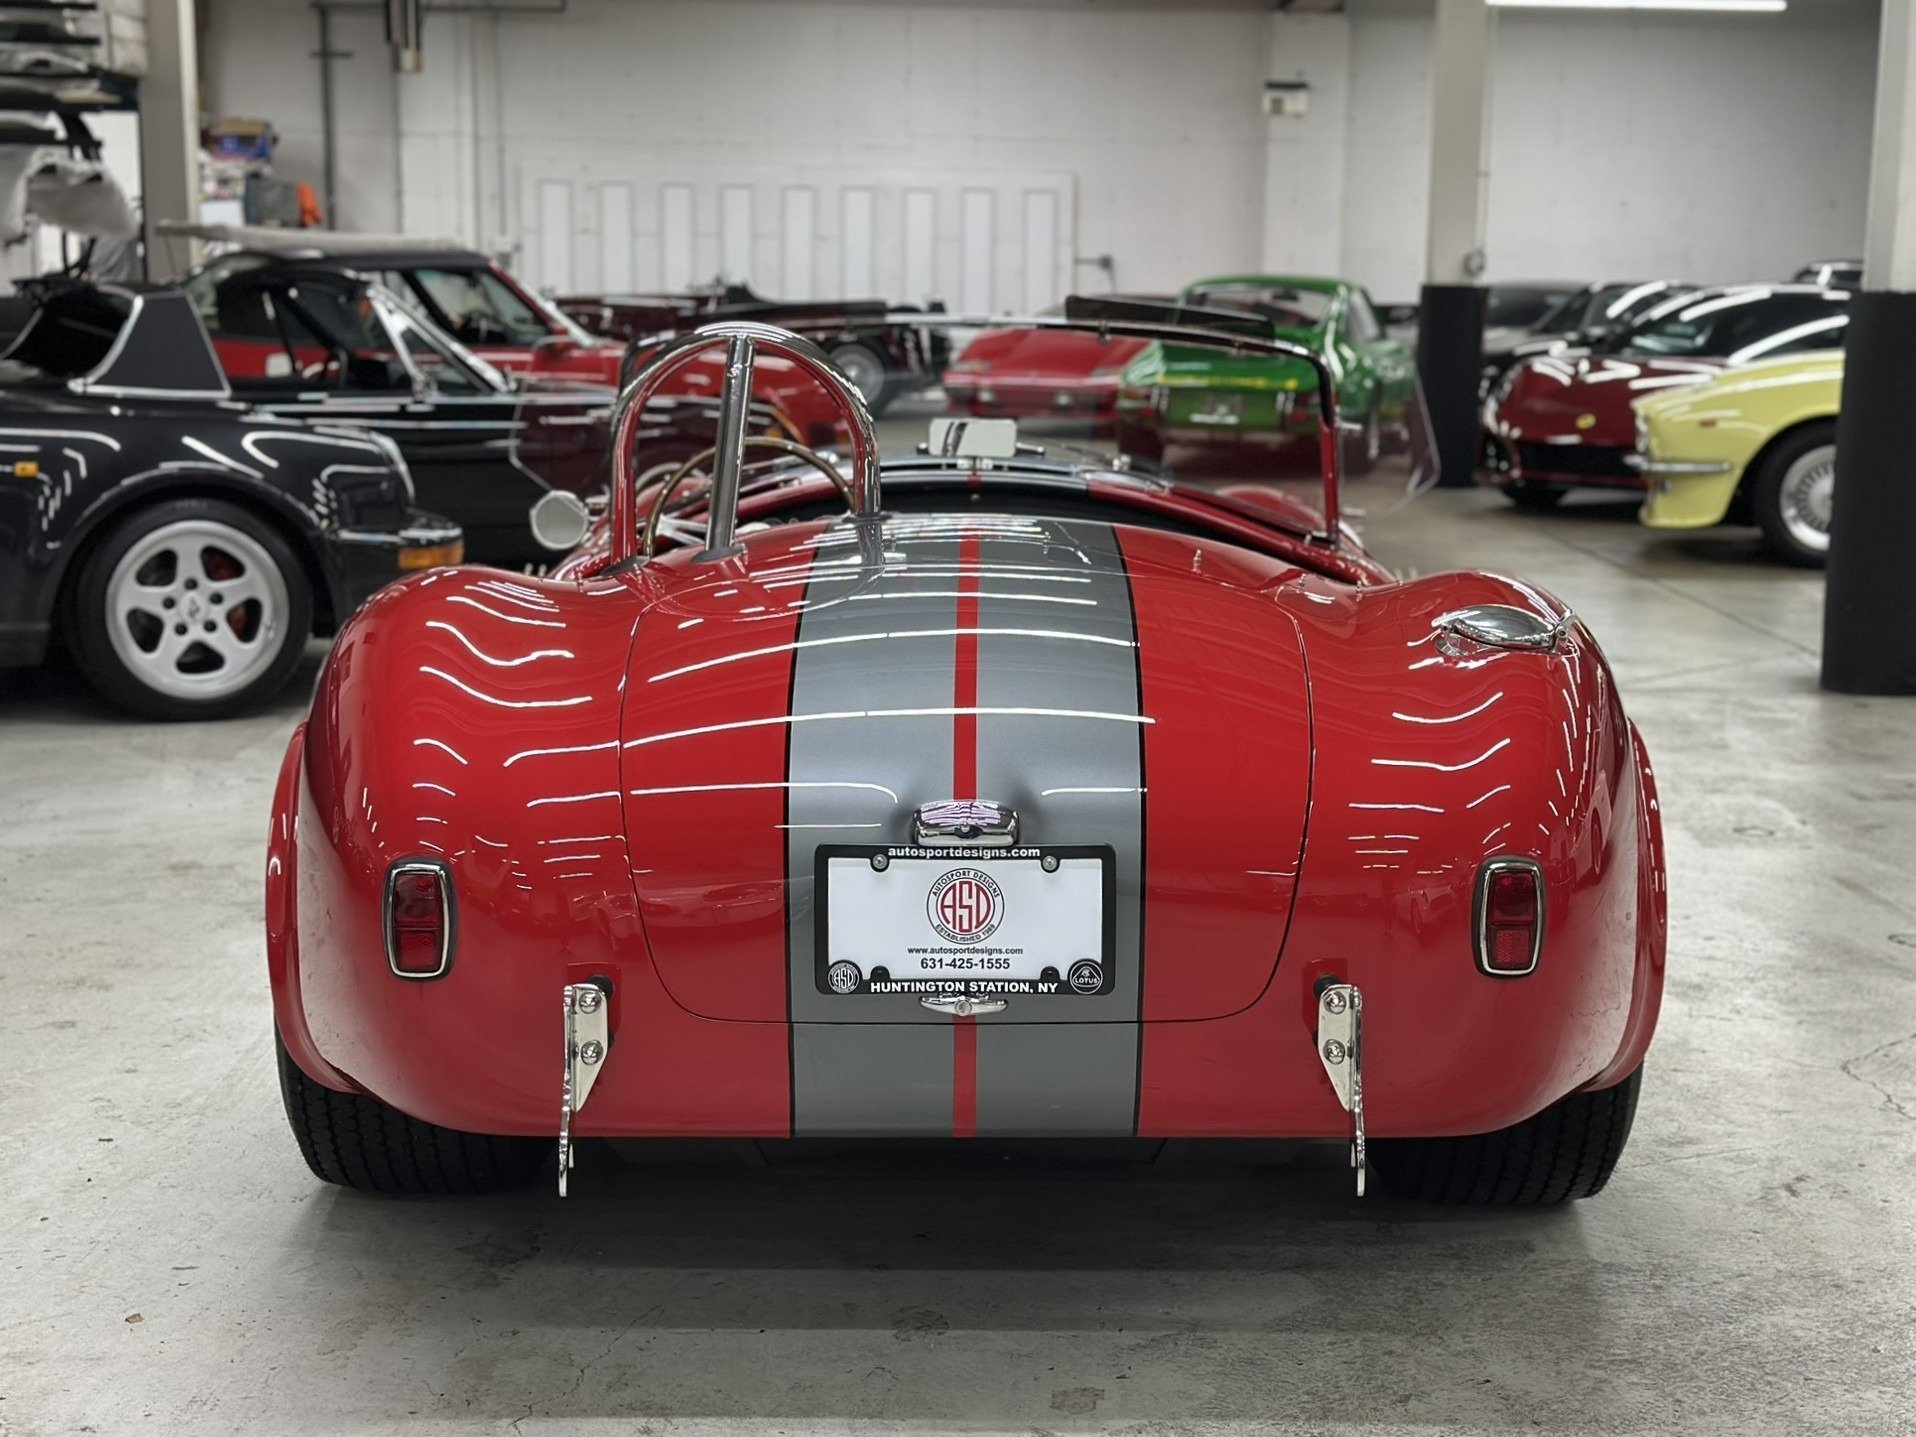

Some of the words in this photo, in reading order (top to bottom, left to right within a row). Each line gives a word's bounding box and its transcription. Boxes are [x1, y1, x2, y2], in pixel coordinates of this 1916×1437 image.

[888, 847, 1040, 859] autosportdesigns.com
[932, 870, 971, 897] AUTOSPORT
[973, 870, 1000, 898] DESIGNS
[940, 880, 991, 933] ASD
[936, 924, 981, 942] ESTABLISHED
[908, 946, 1023, 956] www.autosportdesigns.com
[920, 958, 1010, 969] 631-425-1555
[870, 981, 965, 993] HUNTINGTON
[969, 981, 1034, 994] STATION,
[1038, 982, 1058, 993] NY
